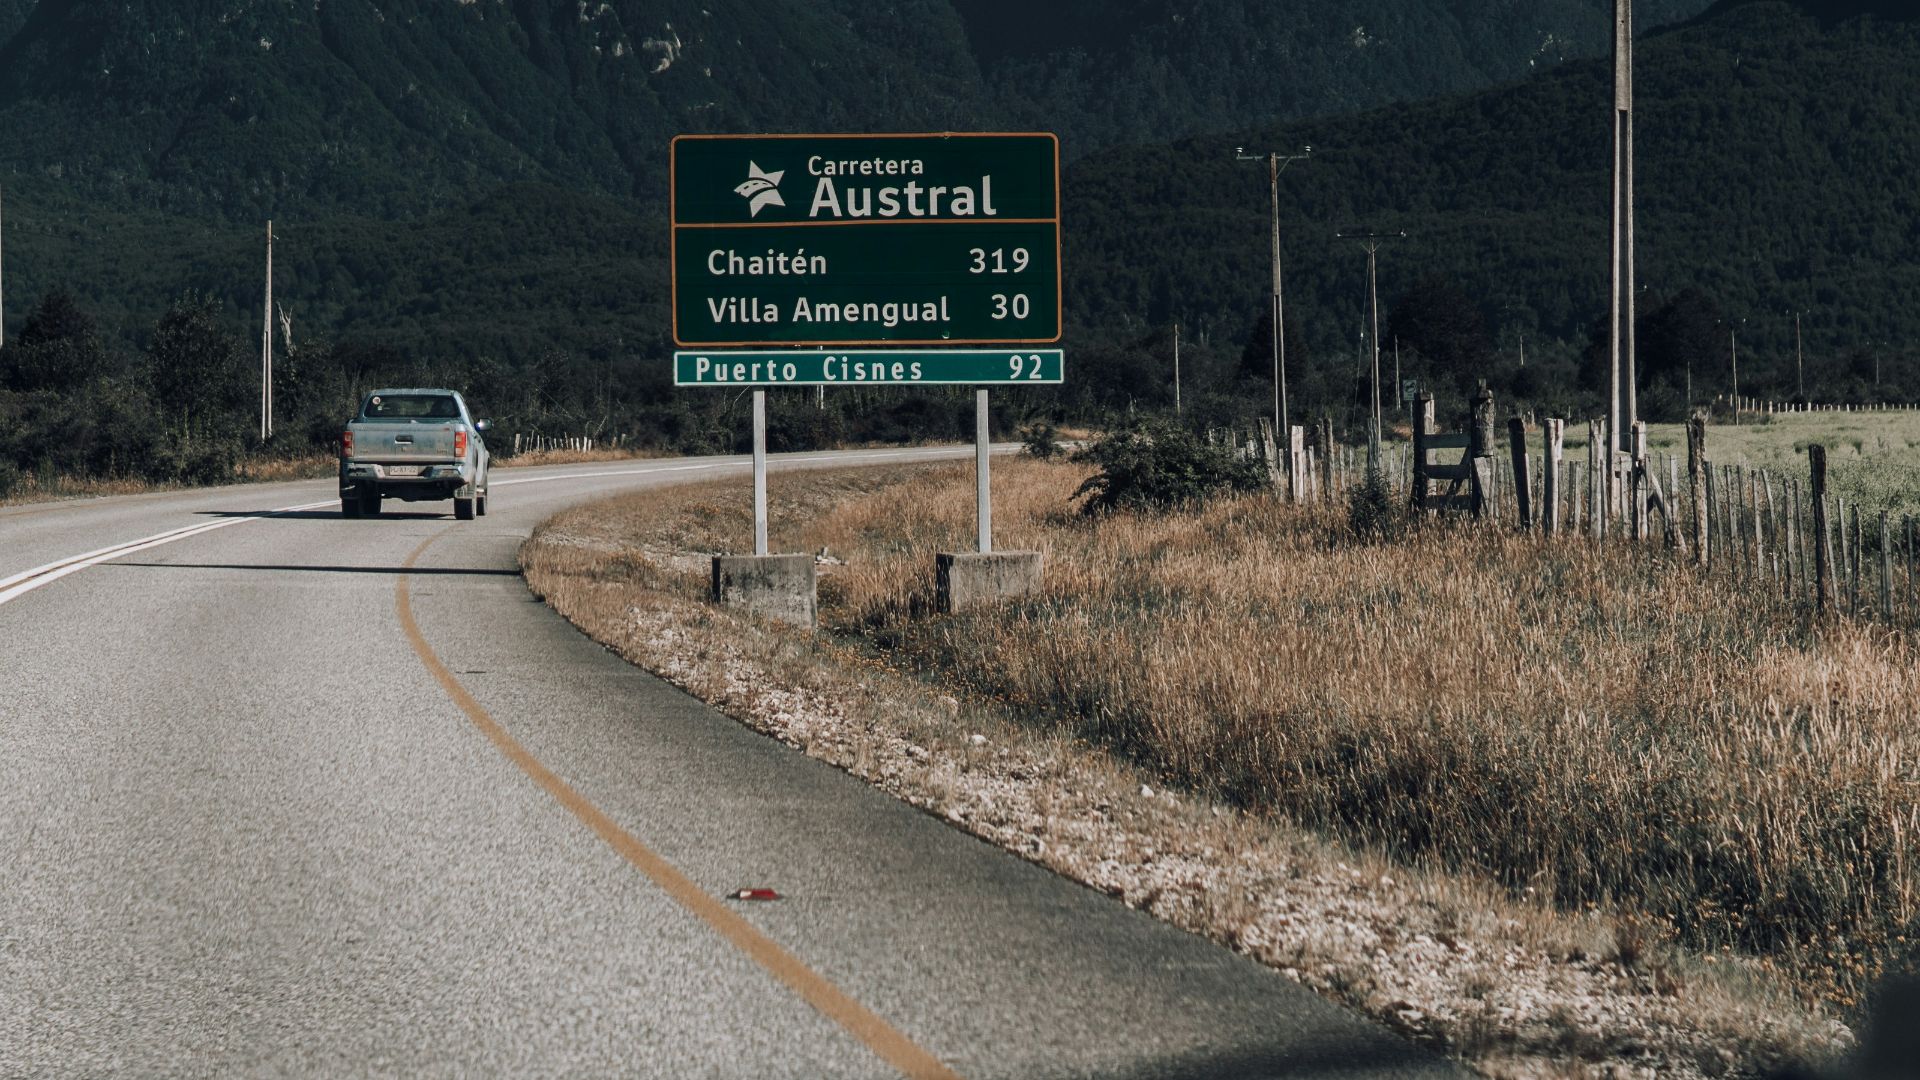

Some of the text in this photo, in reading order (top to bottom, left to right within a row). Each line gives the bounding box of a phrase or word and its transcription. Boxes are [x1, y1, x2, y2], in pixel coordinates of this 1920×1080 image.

[808, 155, 924, 175] Carretera
[809, 174, 997, 218] Austral
[708, 247, 1030, 275] Chaitén 319
[707, 293, 1030, 328] Villa Amengual 30
[696, 354, 1044, 382] Puerto Cisnes 92
